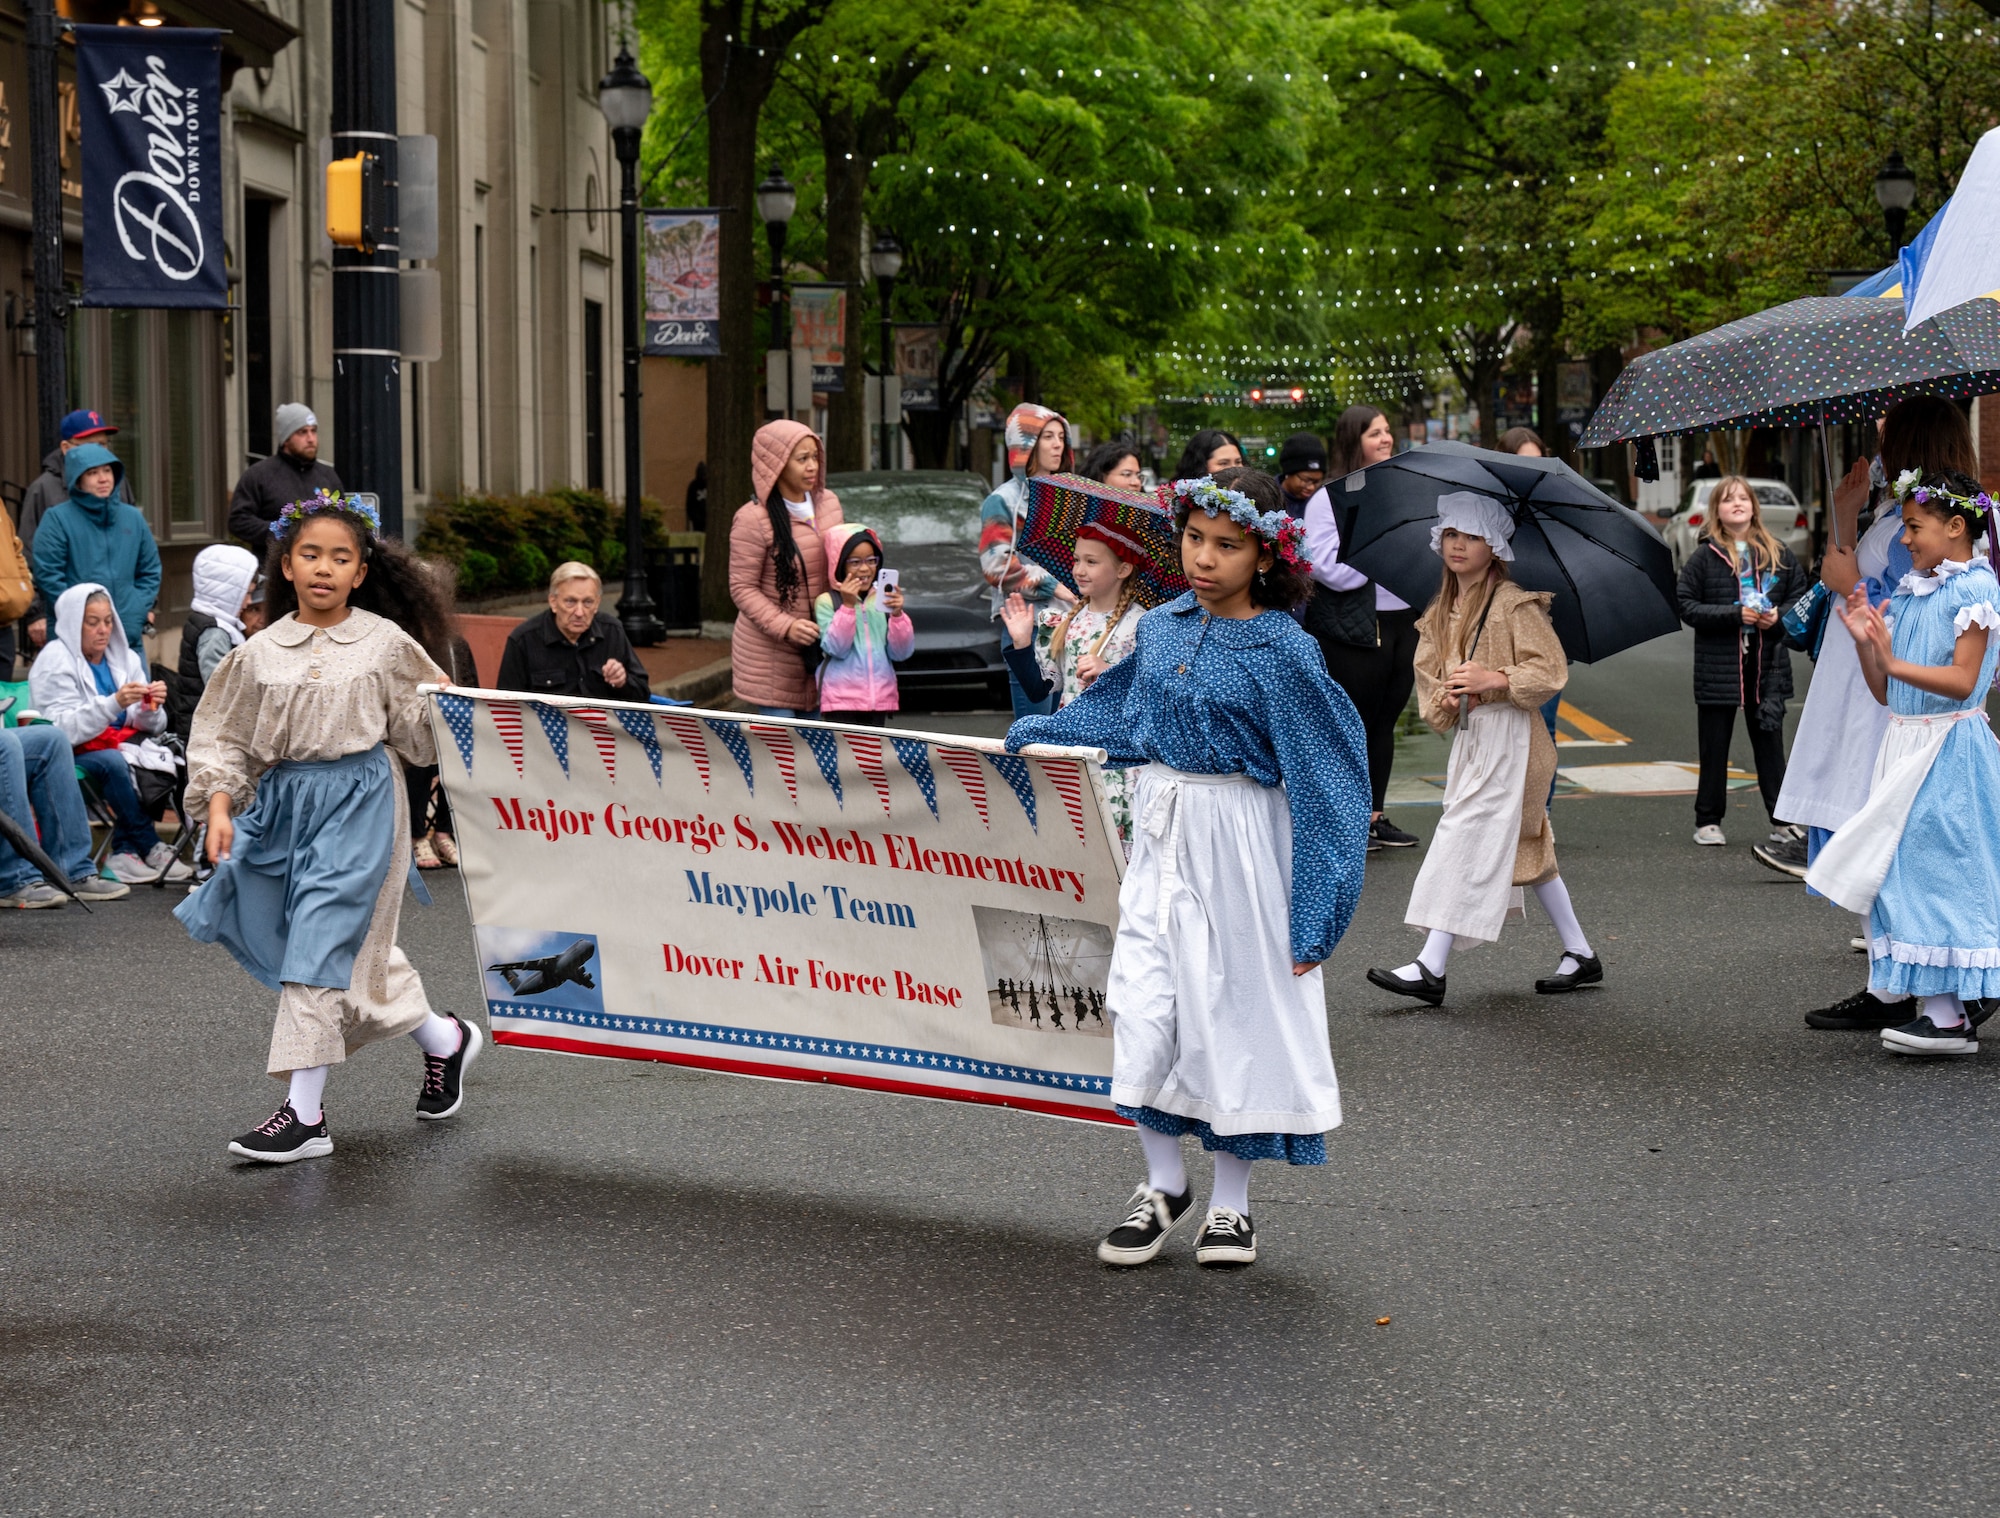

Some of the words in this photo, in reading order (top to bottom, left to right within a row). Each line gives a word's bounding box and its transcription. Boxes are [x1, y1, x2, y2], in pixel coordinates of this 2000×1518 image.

[114, 55, 205, 281] Dover
[186, 86, 201, 203] DOWNTOWN
[1792, 601, 1810, 623] NDS
[1800, 594, 1812, 611] UR
[490, 797, 596, 842] Major
[603, 803, 726, 853] George
[733, 815, 771, 853] S.
[772, 820, 877, 867] Welch
[883, 833, 1086, 903] Elementary
[685, 869, 817, 917] Maypole
[822, 884, 917, 929] Team
[662, 943, 744, 980] Dover
[757, 953, 799, 987] Air
[807, 959, 888, 996] Force
[894, 970, 963, 1008] Base
